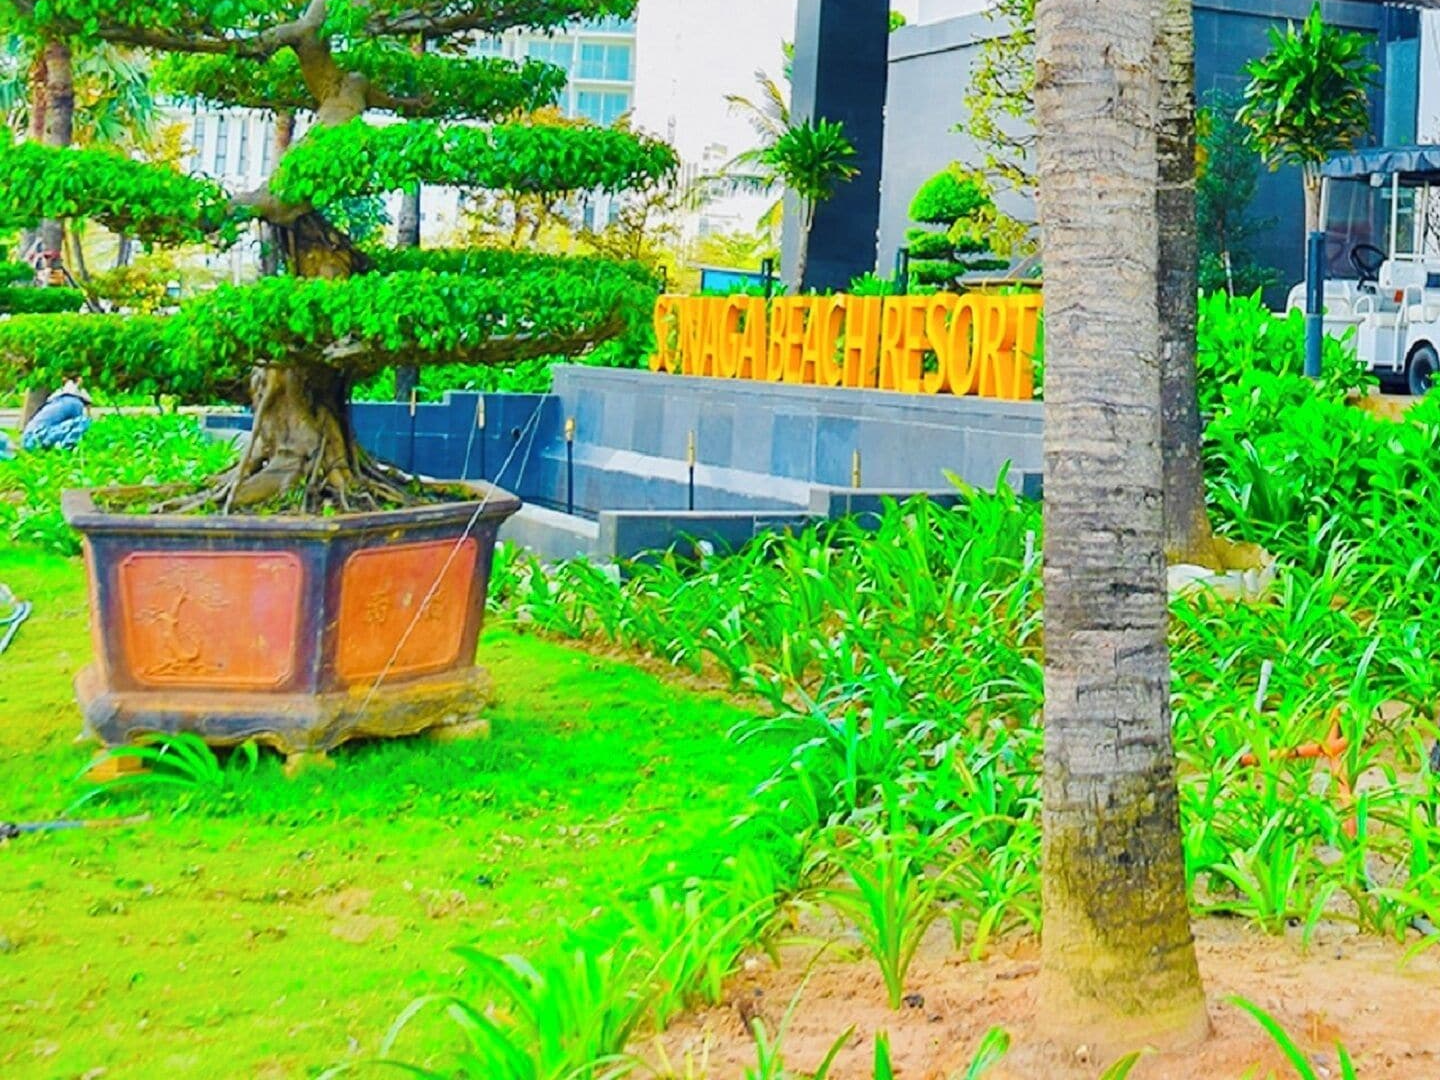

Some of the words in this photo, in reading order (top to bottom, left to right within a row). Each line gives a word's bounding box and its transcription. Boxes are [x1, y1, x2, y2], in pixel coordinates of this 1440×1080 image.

[649, 294, 767, 381] SONAGA
[766, 294, 882, 388] BEACH
[878, 291, 1043, 400] RESORT
